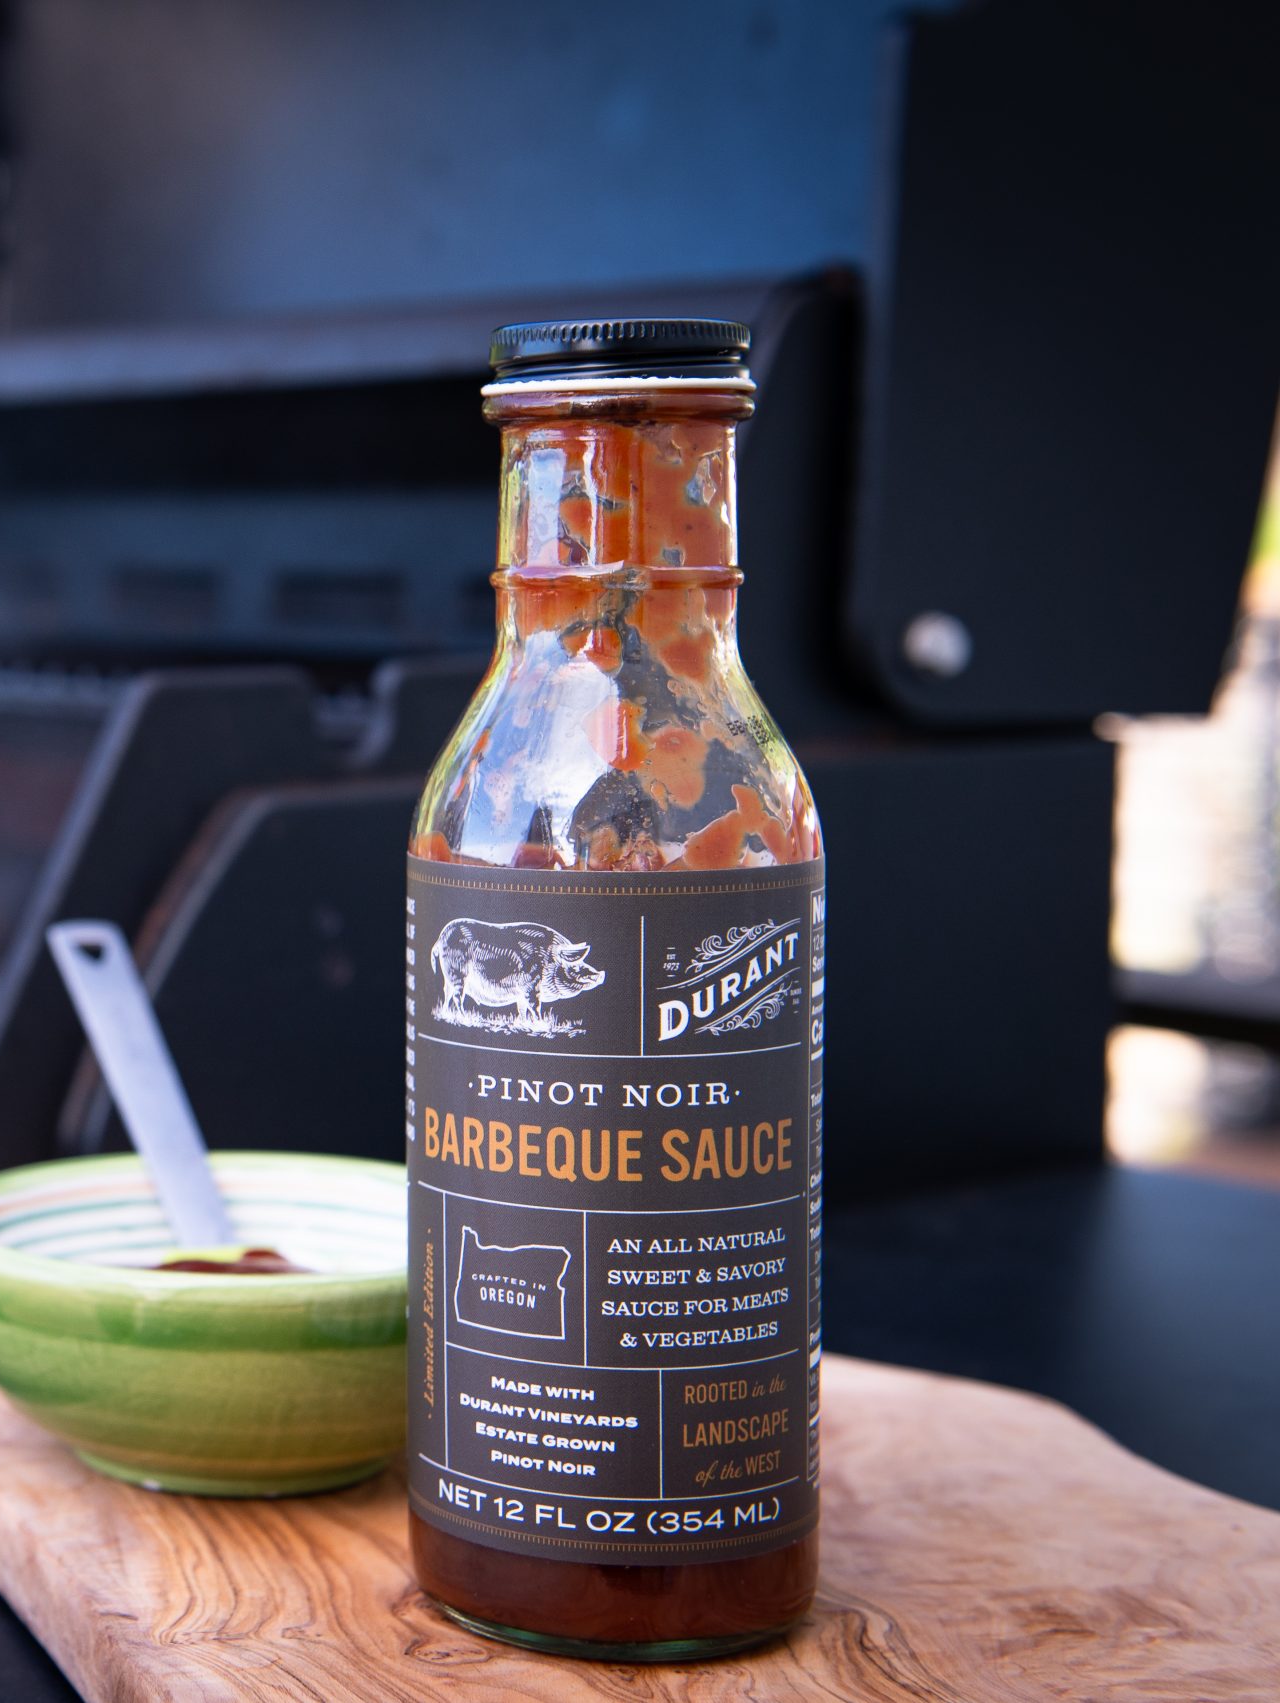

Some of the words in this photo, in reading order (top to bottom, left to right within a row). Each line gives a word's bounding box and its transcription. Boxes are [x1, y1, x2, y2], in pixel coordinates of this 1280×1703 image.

[663, 962, 681, 972] 1973
[658, 932, 800, 1042] DURANT
[477, 1074, 604, 1107] PINOT
[622, 1082, 731, 1108] NOIR
[425, 1107, 644, 1183] BARBEQUE
[660, 1118, 793, 1182] SAUCE
[607, 1238, 642, 1254] AN
[647, 1238, 693, 1254] ALL
[697, 1227, 786, 1253] NATURAL
[423, 1242, 434, 1320] Edition
[471, 1272, 527, 1288] CRAFTED
[533, 1282, 548, 1292] IN
[607, 1269, 691, 1285] SWEET
[696, 1268, 712, 1284] &
[717, 1257, 787, 1282] SAVORY
[480, 1286, 537, 1310] OREGON
[601, 1301, 679, 1317] SAUCE
[684, 1298, 729, 1316] FOR
[732, 1287, 789, 1312] MEATS
[620, 1332, 638, 1348] &
[643, 1320, 779, 1348] VEGETABLES
[423, 1322, 435, 1408] Limited
[491, 1376, 542, 1397] MADE
[545, 1385, 596, 1401] WITH
[684, 1379, 748, 1405] ROOTED
[751, 1381, 766, 1398] in
[769, 1373, 787, 1395] the
[459, 1392, 526, 1418] DURANT
[527, 1407, 639, 1429] VINEYARDS
[475, 1421, 539, 1445] ESTATE
[541, 1434, 616, 1452] GROWN
[683, 1408, 789, 1448] LANDSCAPE
[491, 1449, 544, 1471] PINOT
[548, 1460, 597, 1476] NOIR
[695, 1460, 719, 1488] of
[720, 1460, 744, 1481] the
[745, 1450, 781, 1476] WEST
[438, 1478, 487, 1513] NET
[493, 1497, 525, 1522] 12
[535, 1504, 577, 1530] FL
[585, 1510, 637, 1534] OZ
[646, 1509, 725, 1535] (354
[734, 1497, 781, 1527] ML)
